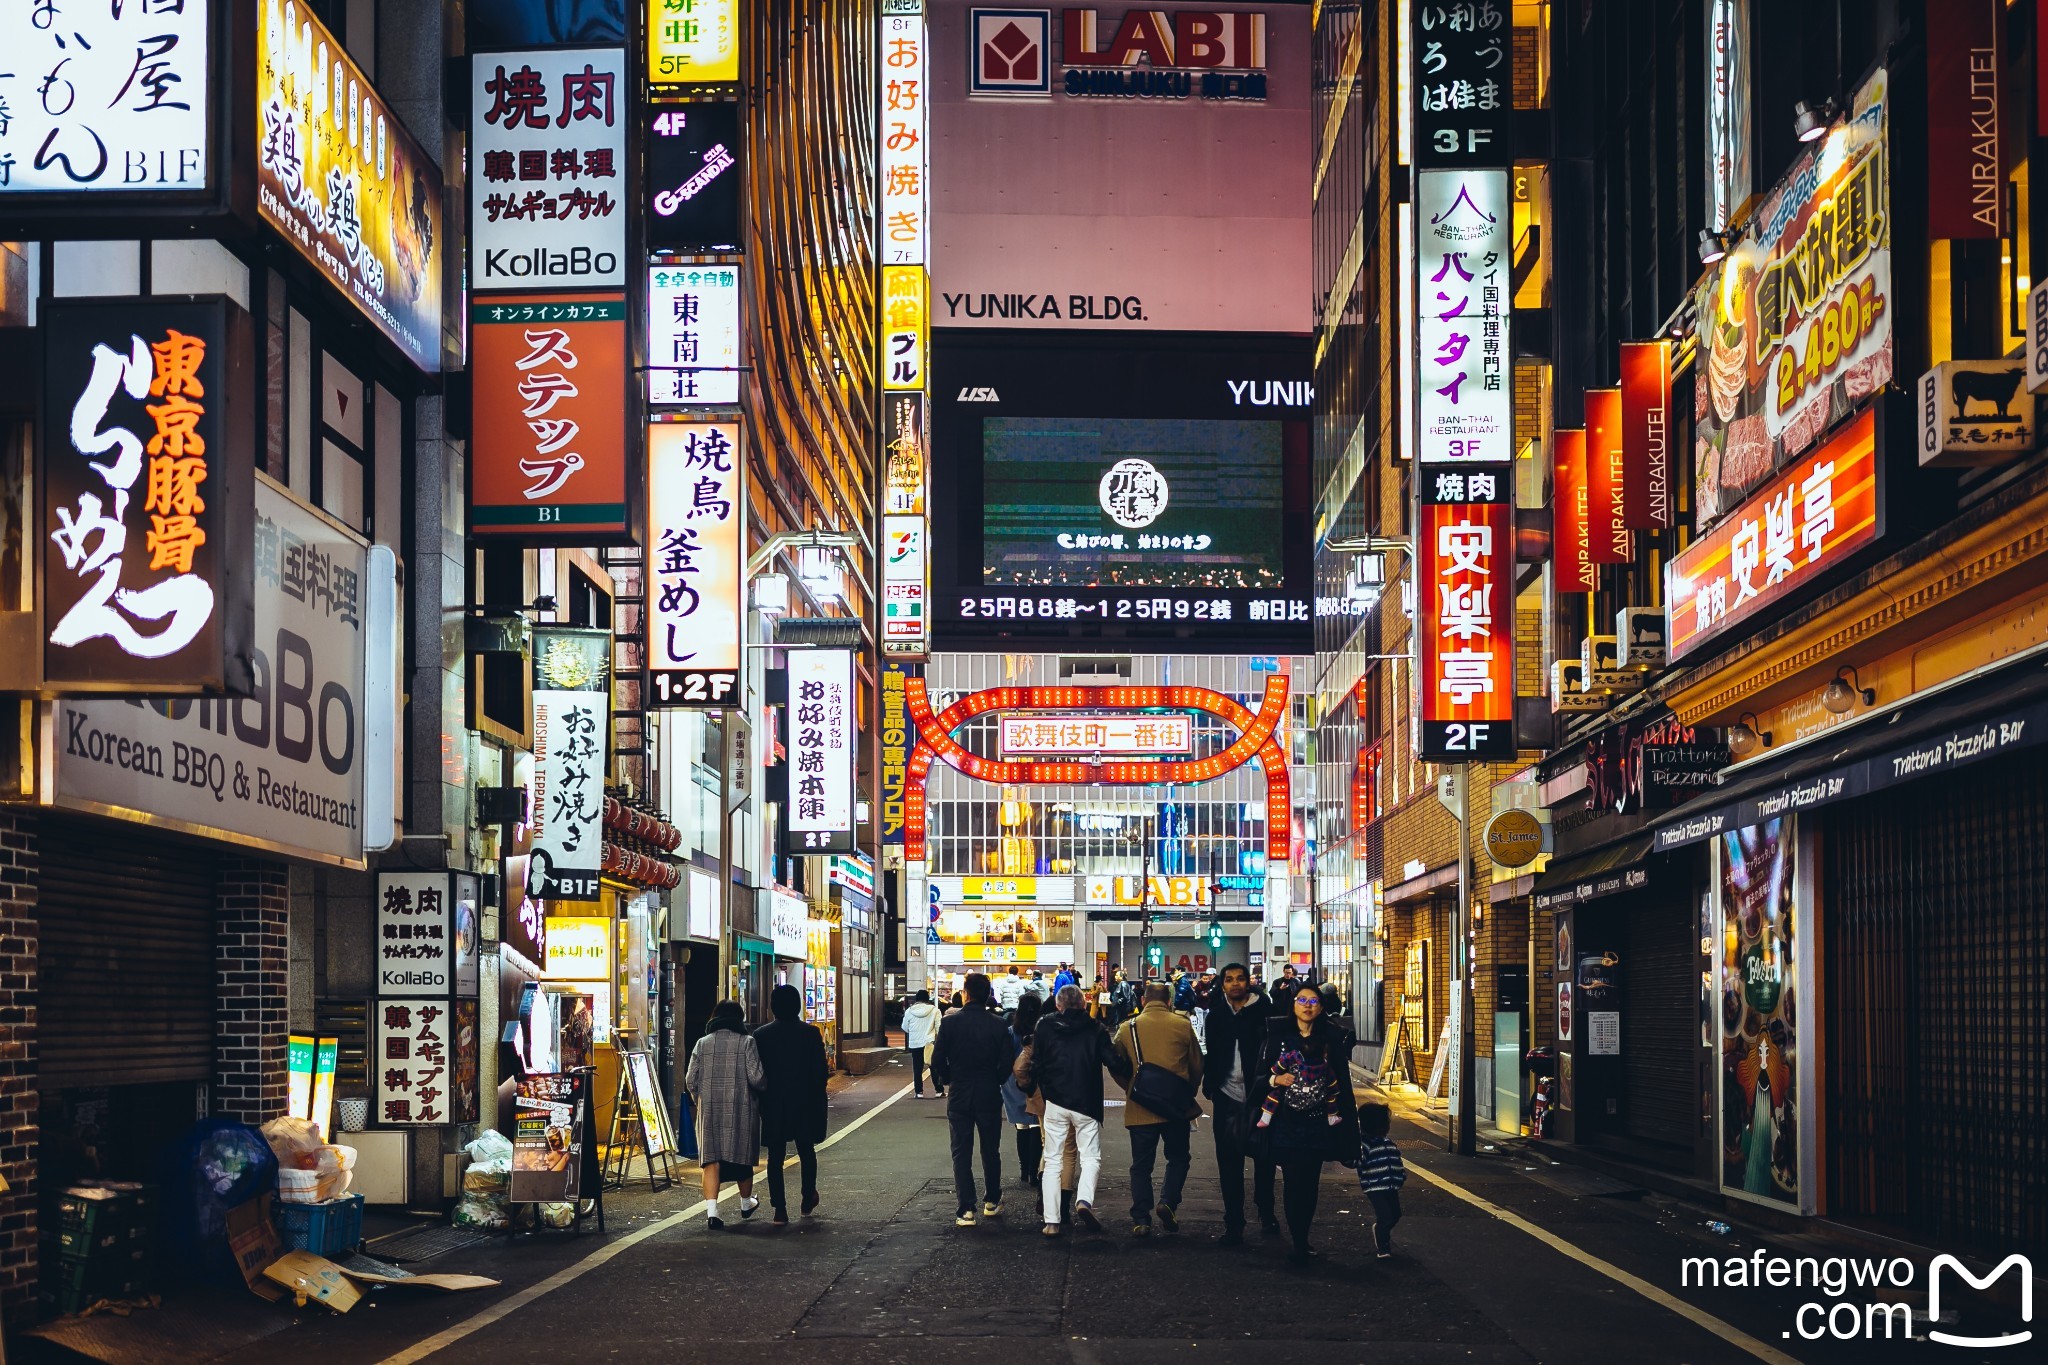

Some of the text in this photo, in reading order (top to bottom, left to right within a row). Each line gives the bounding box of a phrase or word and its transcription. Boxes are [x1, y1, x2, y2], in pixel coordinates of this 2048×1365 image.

[892, 19, 912, 30] 8F
[1062, 10, 1266, 69] LABI
[659, 55, 691, 75] 5F
[1422, 6, 1449, 111] いろは
[484, 64, 616, 131] 焼肉
[1065, 70, 1192, 98] SHINJUKU
[653, 113, 686, 136] 4F
[886, 37, 919, 242] お好み焼き
[1971, 48, 1998, 228] ANRAKUTEI
[1433, 129, 1493, 153] 3F
[123, 149, 200, 184] B1F
[483, 147, 617, 183] 韓国料理
[654, 154, 735, 217] G-SCANDAL
[482, 187, 617, 222] サムギョプサル
[1433, 227, 1495, 241] RESTAURANT
[1441, 222, 1487, 234] BAN-THAI
[484, 247, 618, 278] KollaBo
[894, 250, 913, 262] 7F
[1757, 146, 1882, 360] 食べ放題!
[353, 279, 366, 300] TEL
[655, 271, 734, 288] 全卓全自動
[491, 305, 609, 320] オンラインカフェ
[943, 293, 1149, 321] YUNIKA BLDG.
[1483, 251, 1501, 391] タイ国料理専門店
[1431, 252, 1475, 405] バンタイ
[672, 293, 699, 399] 東南荘
[957, 387, 1000, 402] LISA
[515, 328, 585, 500] ステップ
[1438, 415, 1493, 425] BAN-THAI
[1924, 375, 1937, 454] BBQ
[1430, 425, 1500, 435] RESTAURANT
[1947, 426, 2032, 446] 黒毛和牛
[145, 329, 208, 575] 東京豚骨
[1448, 440, 1482, 457] 3F
[684, 428, 732, 521] 焼鳥
[1648, 408, 1667, 523] ANRAKUTEI
[1112, 470, 1158, 495] 刀剣
[1436, 473, 1496, 501] 焼肉
[538, 507, 561, 522] B1
[894, 493, 915, 509] 4F
[1111, 489, 1158, 521] 乱舞
[656, 527, 703, 663] 釜めし
[1249, 599, 1309, 621] 前日比
[1696, 575, 1727, 633] 焼肉
[1439, 519, 1493, 705] 安楽亭
[1592, 674, 1642, 685] 黒毛和牛
[1561, 695, 1608, 706] 黒毛和牛
[1781, 689, 1823, 726] Trattoria
[798, 680, 826, 820] お好み焼本陣
[1008, 724, 1184, 748] 歌舞伎町一番街
[1445, 723, 1490, 750] 2F
[1893, 720, 2025, 778] Trattoria Pizzeria Bar
[66, 709, 358, 831] Korean BBQ & Restaurant
[735, 730, 746, 789] 劇場通り一番街
[1646, 746, 1729, 765] Trattoria
[533, 704, 548, 839] HIROSHIMA TEPPANYAKI
[551, 704, 600, 853] お好み焼き
[1757, 776, 1844, 818] Trattoria Pizzeria Bar
[805, 831, 832, 848] 2F
[1661, 815, 1725, 846] Trattoria Pizzeria Bar
[383, 885, 443, 915] 焼肉
[560, 878, 599, 895] B1F
[1115, 877, 1212, 906] LABI
[383, 925, 443, 939] 韓国料理
[383, 944, 444, 959] サムギョプサル
[383, 971, 445, 985] KollaBo
[384, 1005, 412, 1121] 韓国料理
[416, 1006, 445, 1121] サムギョプサル
